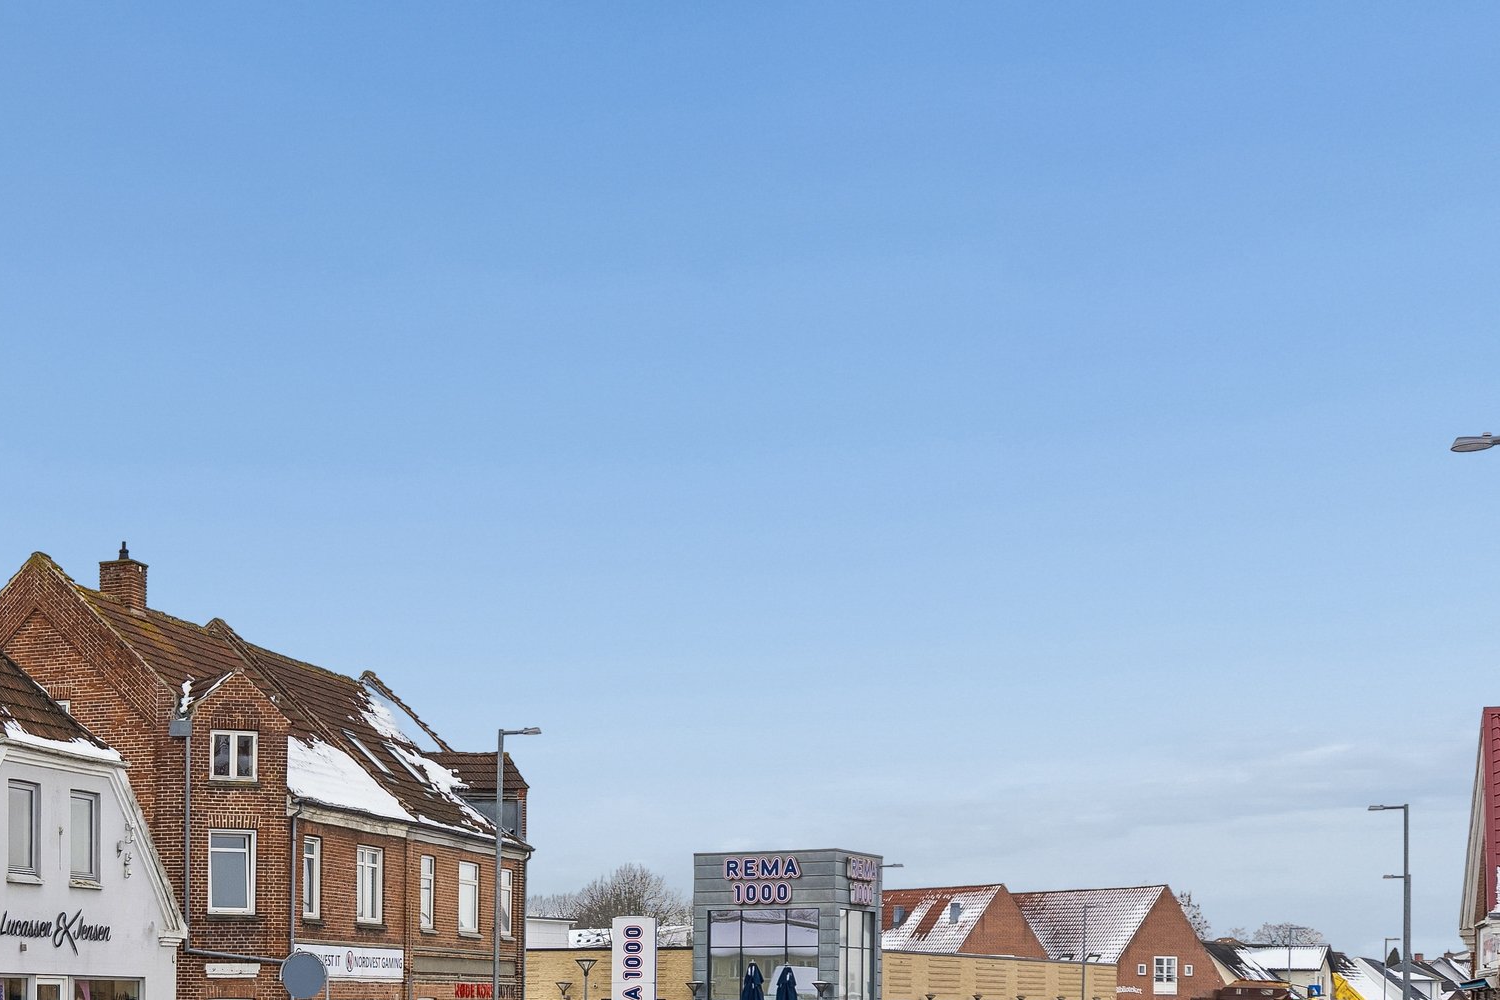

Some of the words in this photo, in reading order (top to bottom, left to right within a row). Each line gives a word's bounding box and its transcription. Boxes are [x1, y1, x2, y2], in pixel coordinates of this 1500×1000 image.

[724, 856, 800, 880] REMA
[850, 857, 877, 880] REMA
[732, 882, 791, 904] 1000
[850, 882, 873, 905] 1000
[0, 910, 52, 938] Lucassen
[73, 916, 111, 942] Jensen
[354, 957, 381, 969] NORDVEST
[381, 957, 402, 969] GAMING
[623, 925, 643, 981] 1000
[455, 983, 475, 999] RØDE
